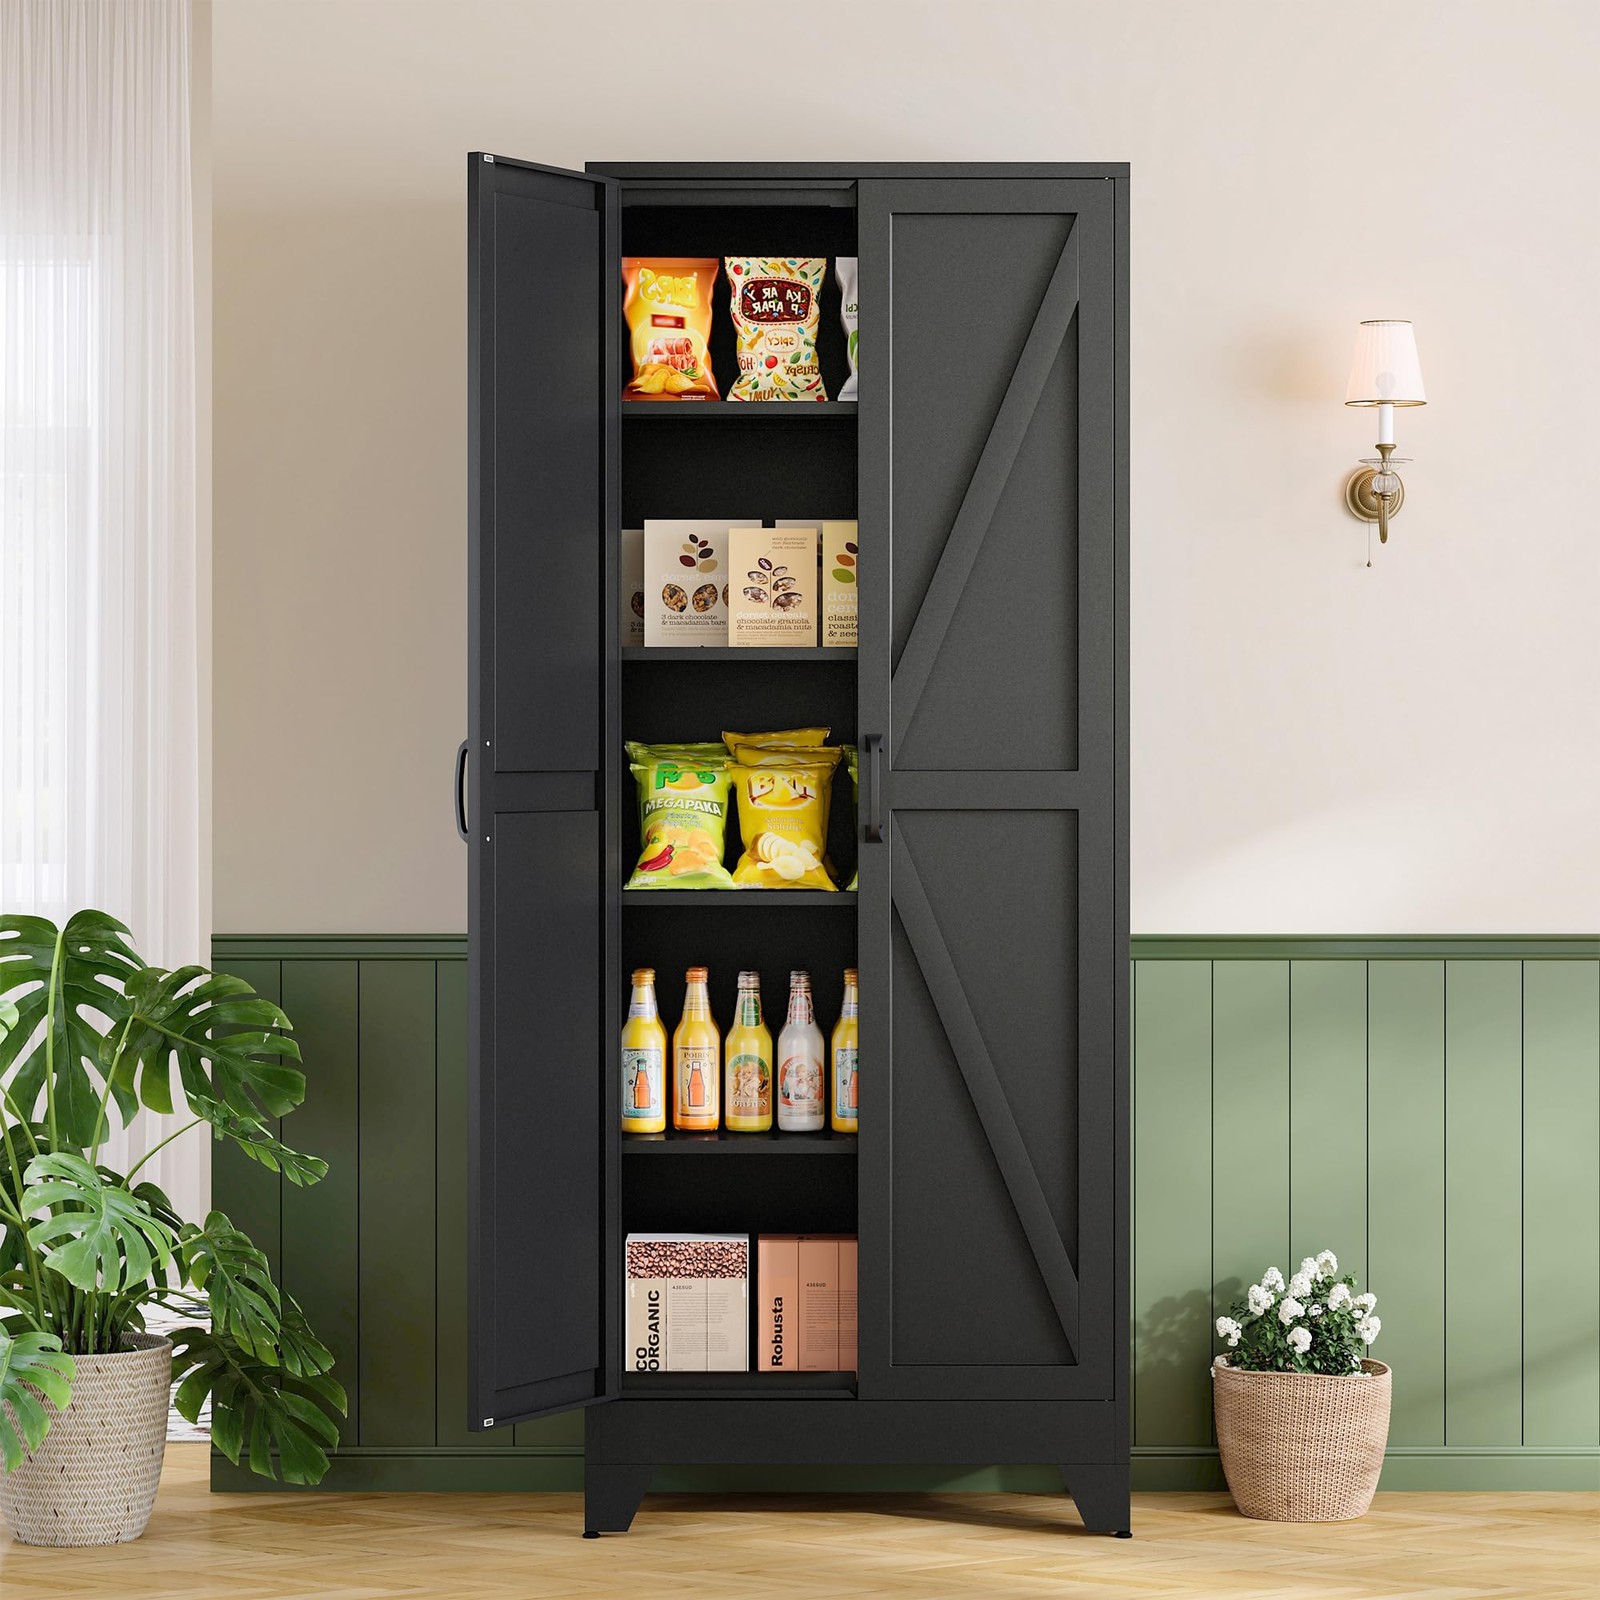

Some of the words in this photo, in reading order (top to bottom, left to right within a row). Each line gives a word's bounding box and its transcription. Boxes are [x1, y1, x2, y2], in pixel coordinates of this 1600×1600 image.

[777, 618, 810, 626] granola
[645, 797, 722, 816] MEGAPAKA
[648, 1290, 660, 1371] ORGANIC
[771, 1297, 783, 1366] Robusta
[636, 1347, 648, 1371] CO
